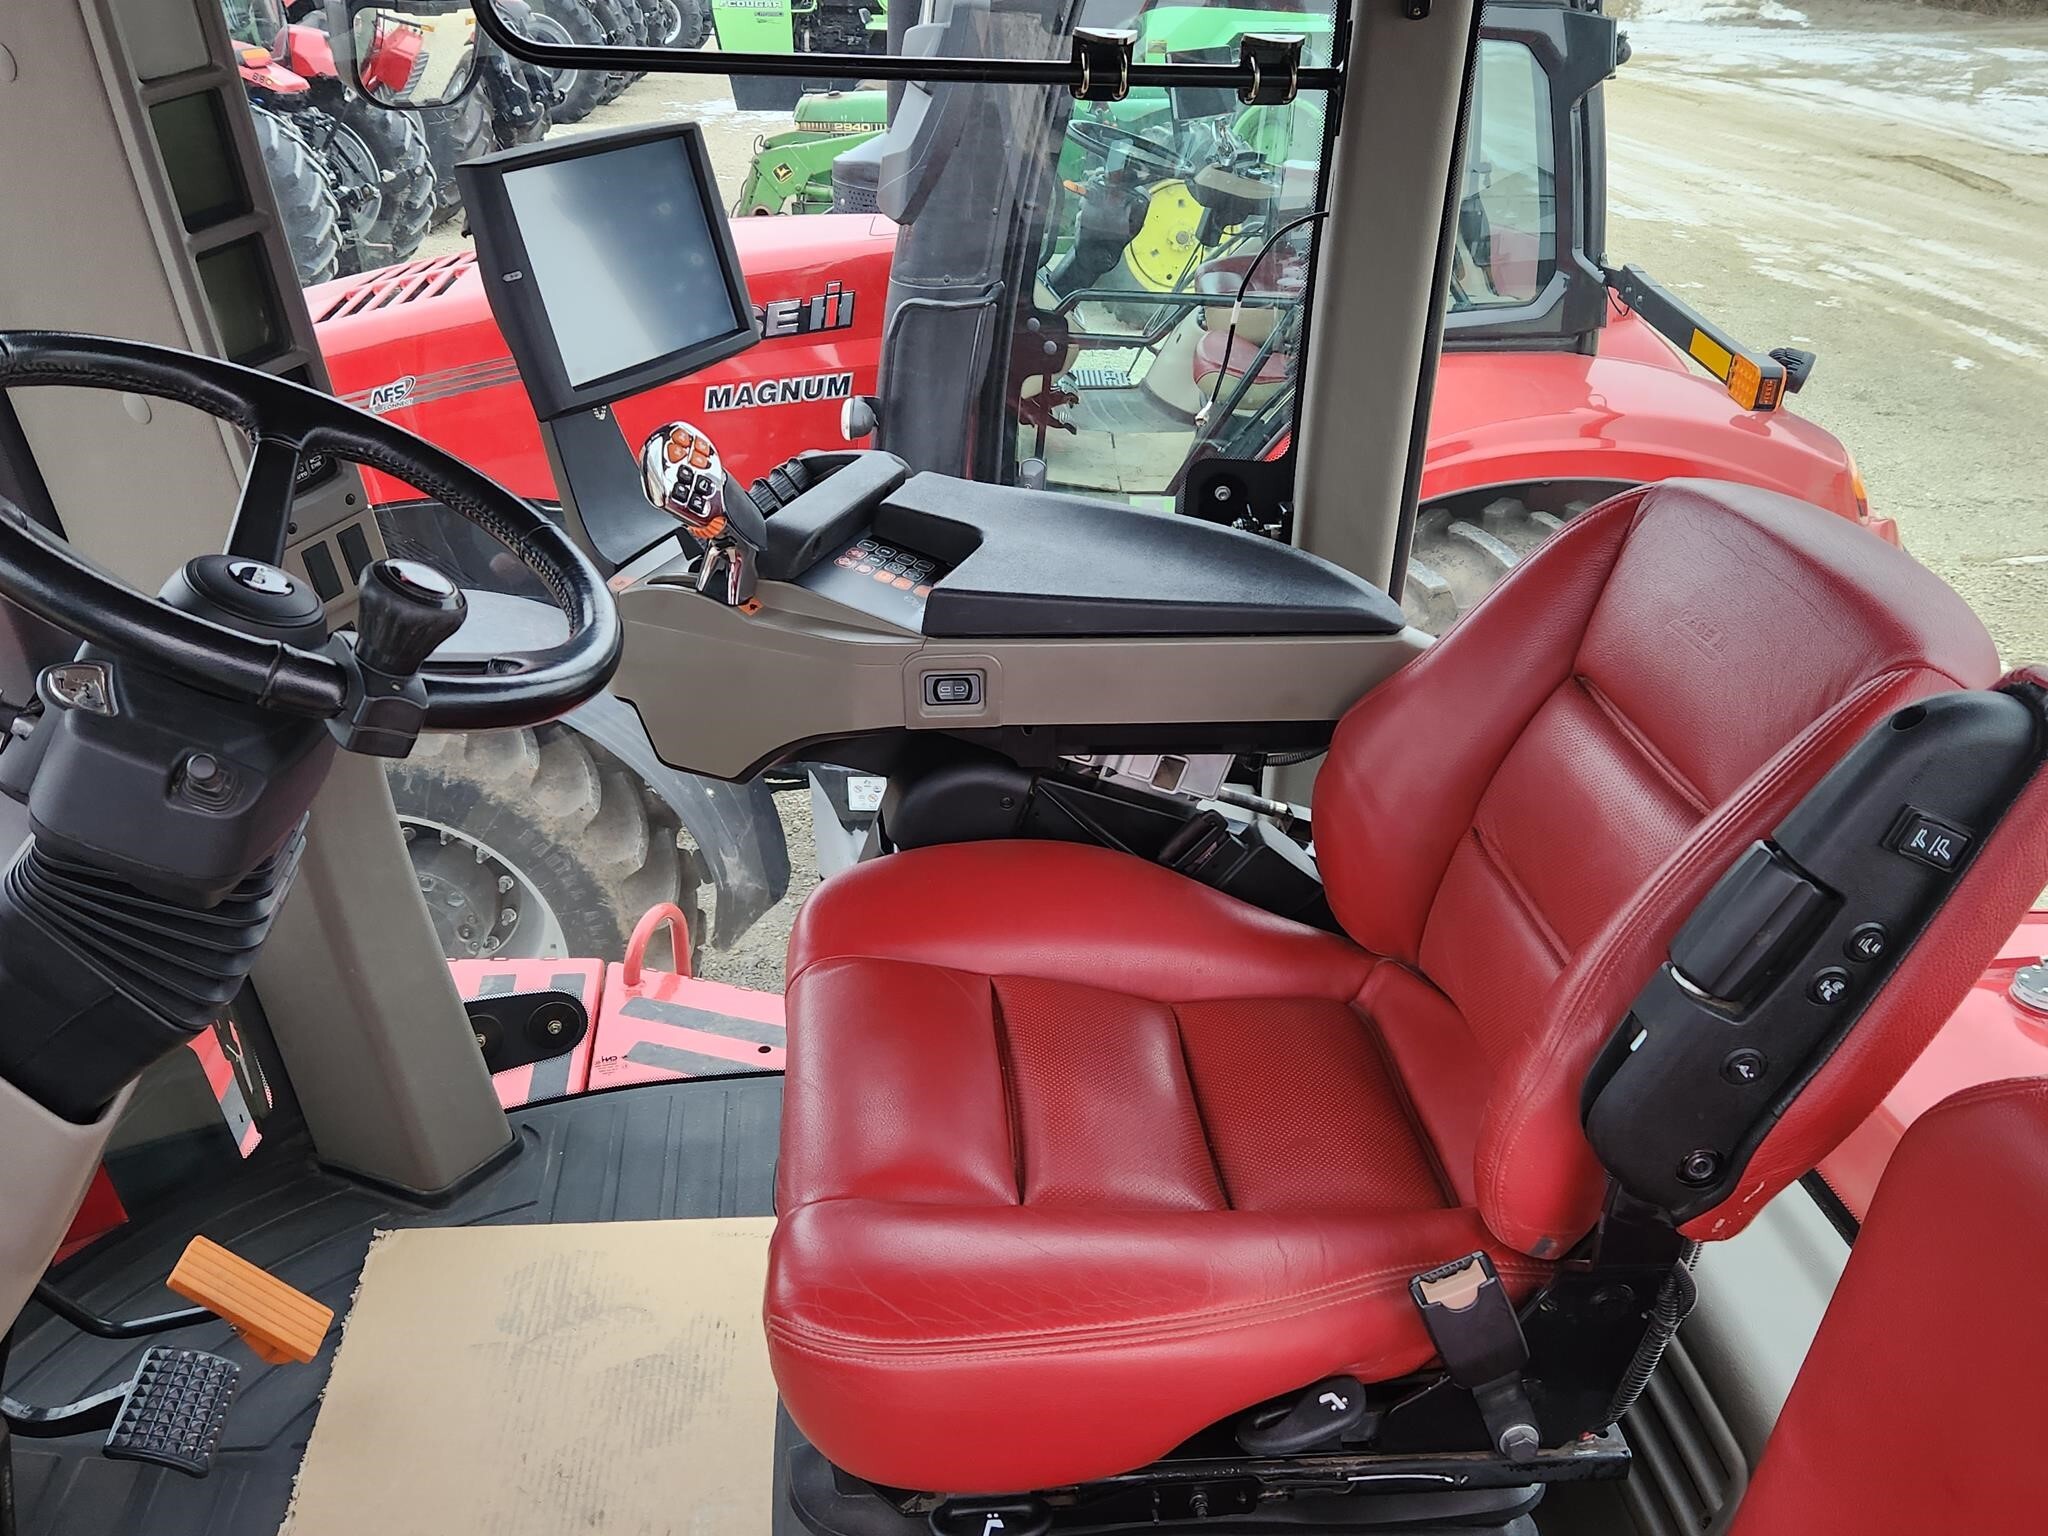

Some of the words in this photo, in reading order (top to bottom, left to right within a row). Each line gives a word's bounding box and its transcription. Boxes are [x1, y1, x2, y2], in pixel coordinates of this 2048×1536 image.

[834, 122, 870, 132] 2940
[372, 384, 406, 406] AFS
[705, 373, 853, 411] MAGNUM
[383, 398, 413, 410] CONNECT
